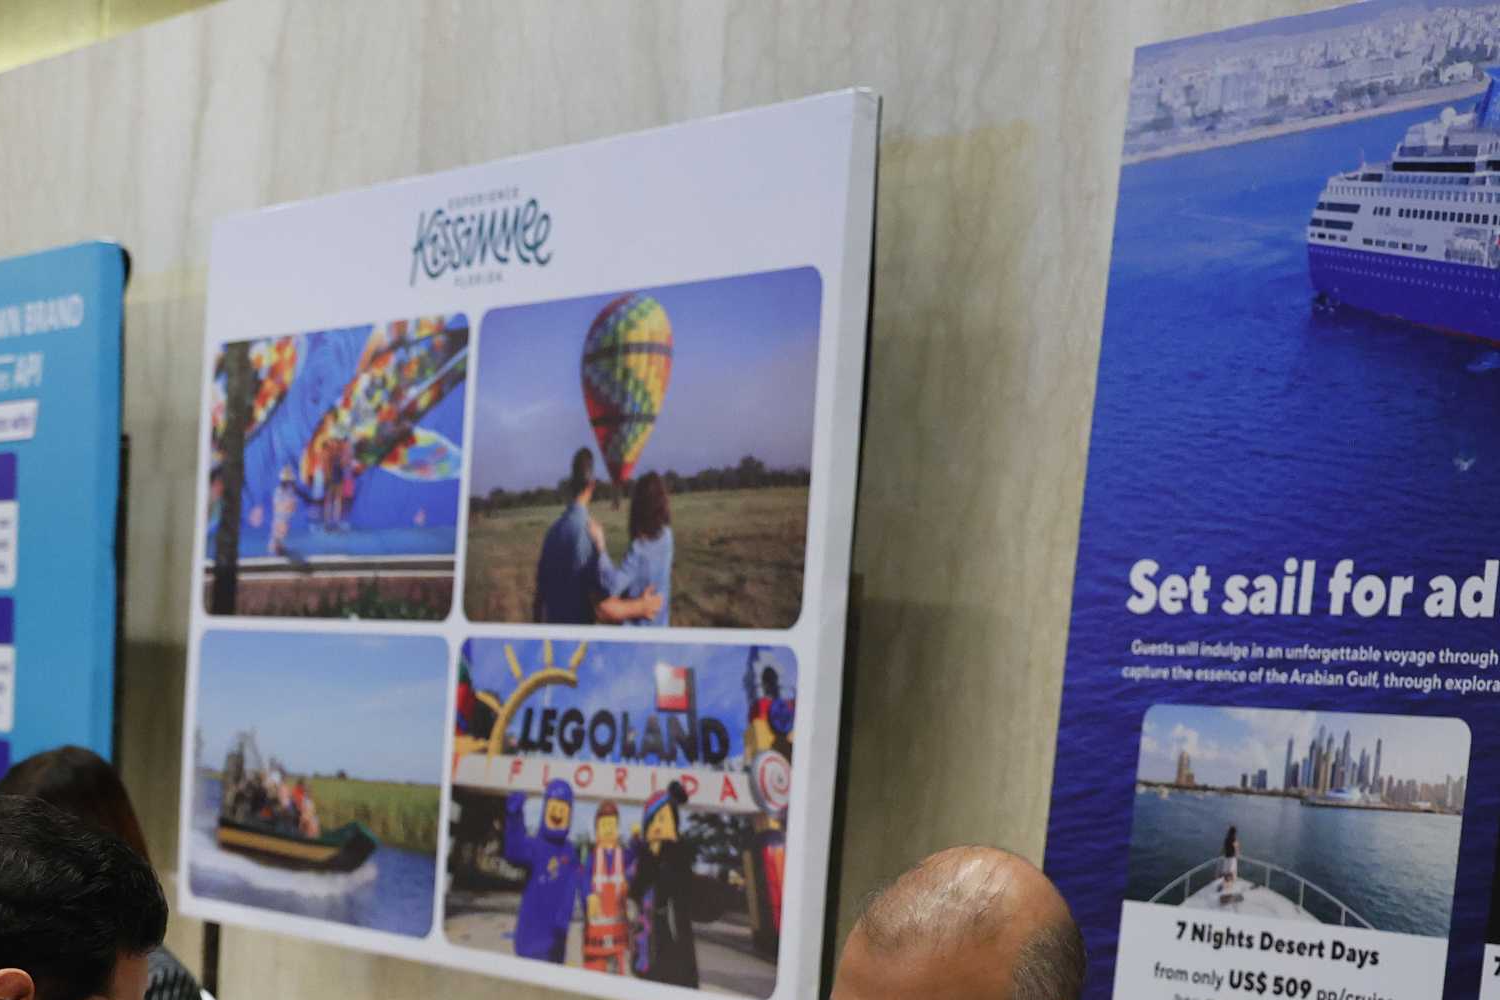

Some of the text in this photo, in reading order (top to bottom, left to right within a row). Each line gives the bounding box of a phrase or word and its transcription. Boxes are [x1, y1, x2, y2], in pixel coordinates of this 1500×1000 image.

[1126, 557, 1499, 617] Set sail for ad
[1131, 639, 1498, 669] Guests will indulge in an unforgettable voyage through
[1122, 665, 1170, 682] capture
[1171, 665, 1193, 681] the
[1194, 668, 1247, 683] essence
[1249, 667, 1264, 683] of
[1266, 667, 1289, 684] the
[1290, 668, 1344, 687] Arabian
[1347, 670, 1380, 689] Gulf,
[1384, 672, 1442, 693] through
[518, 706, 730, 766] LEGOLAND
[1176, 921, 1380, 968] 7 Nights Desert Days
[1153, 962, 1189, 982] from
[1192, 966, 1226, 989] only
[1229, 970, 1268, 995] US$
[1273, 976, 1313, 1000] 509
